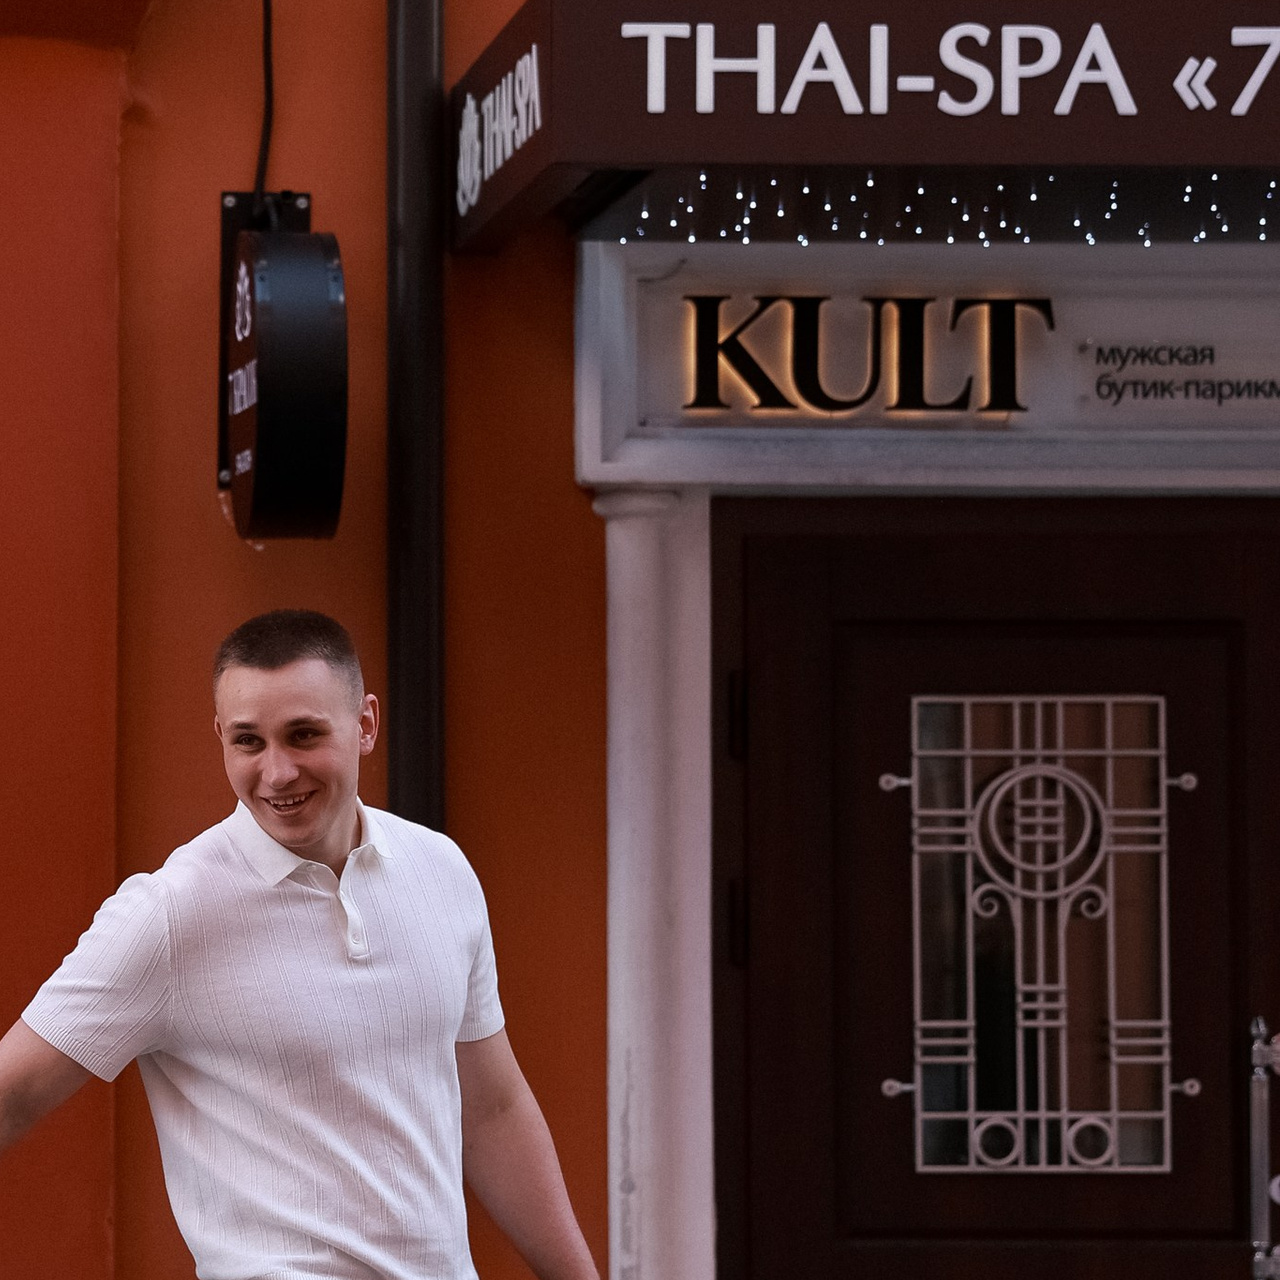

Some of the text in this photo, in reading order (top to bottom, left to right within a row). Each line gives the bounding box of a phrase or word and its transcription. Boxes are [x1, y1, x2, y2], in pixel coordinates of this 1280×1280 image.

[621, 22, 1138, 117] THAI-SPA
[682, 295, 1056, 415] KULT
[1095, 345, 1215, 372] мужская
